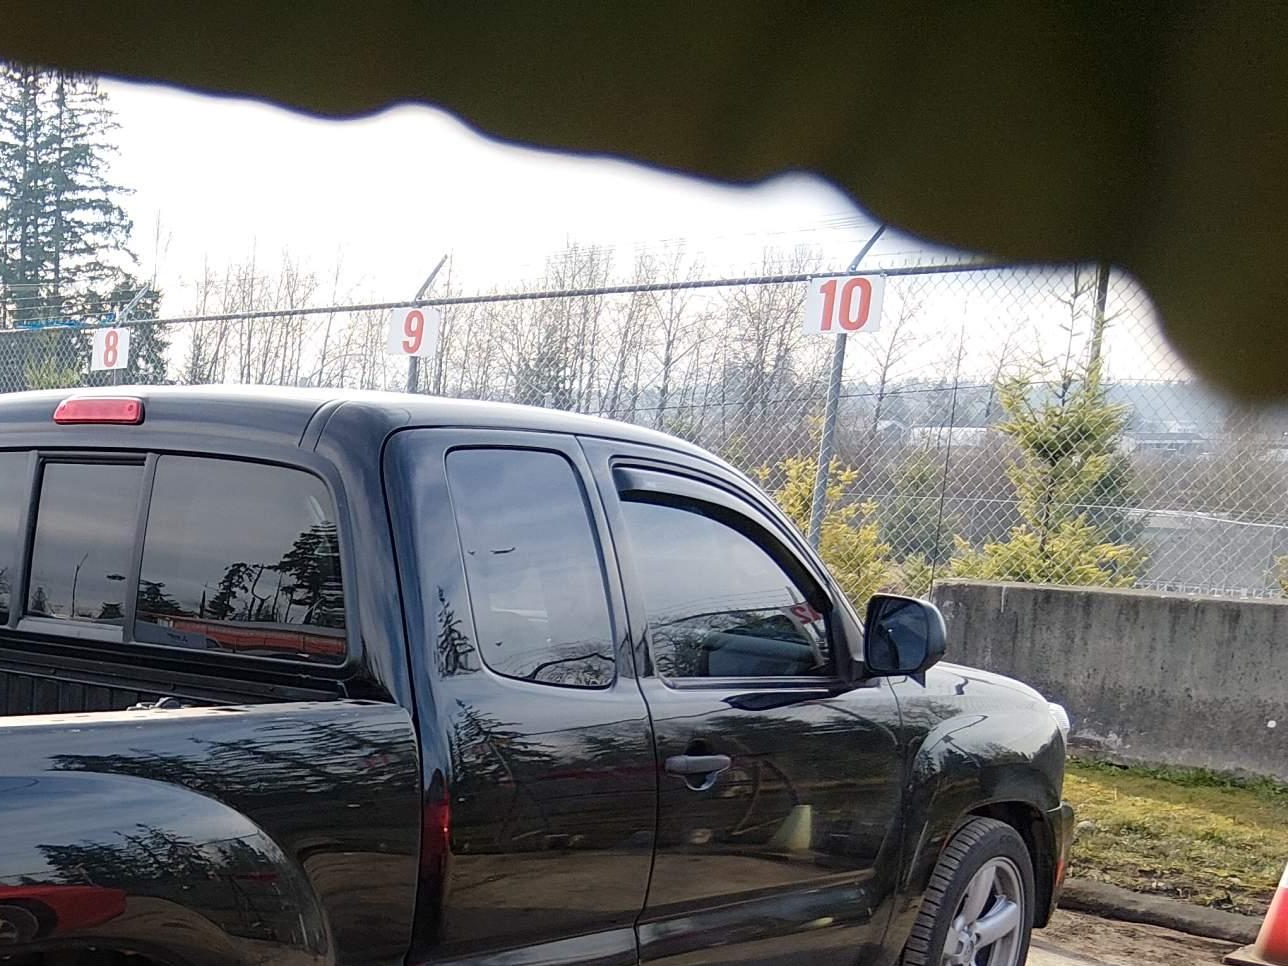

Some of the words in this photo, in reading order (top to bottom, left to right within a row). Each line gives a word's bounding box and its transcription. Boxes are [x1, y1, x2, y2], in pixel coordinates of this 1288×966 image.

[820, 277, 873, 331] 10
[103, 329, 120, 368] 8
[402, 310, 425, 354] 9
